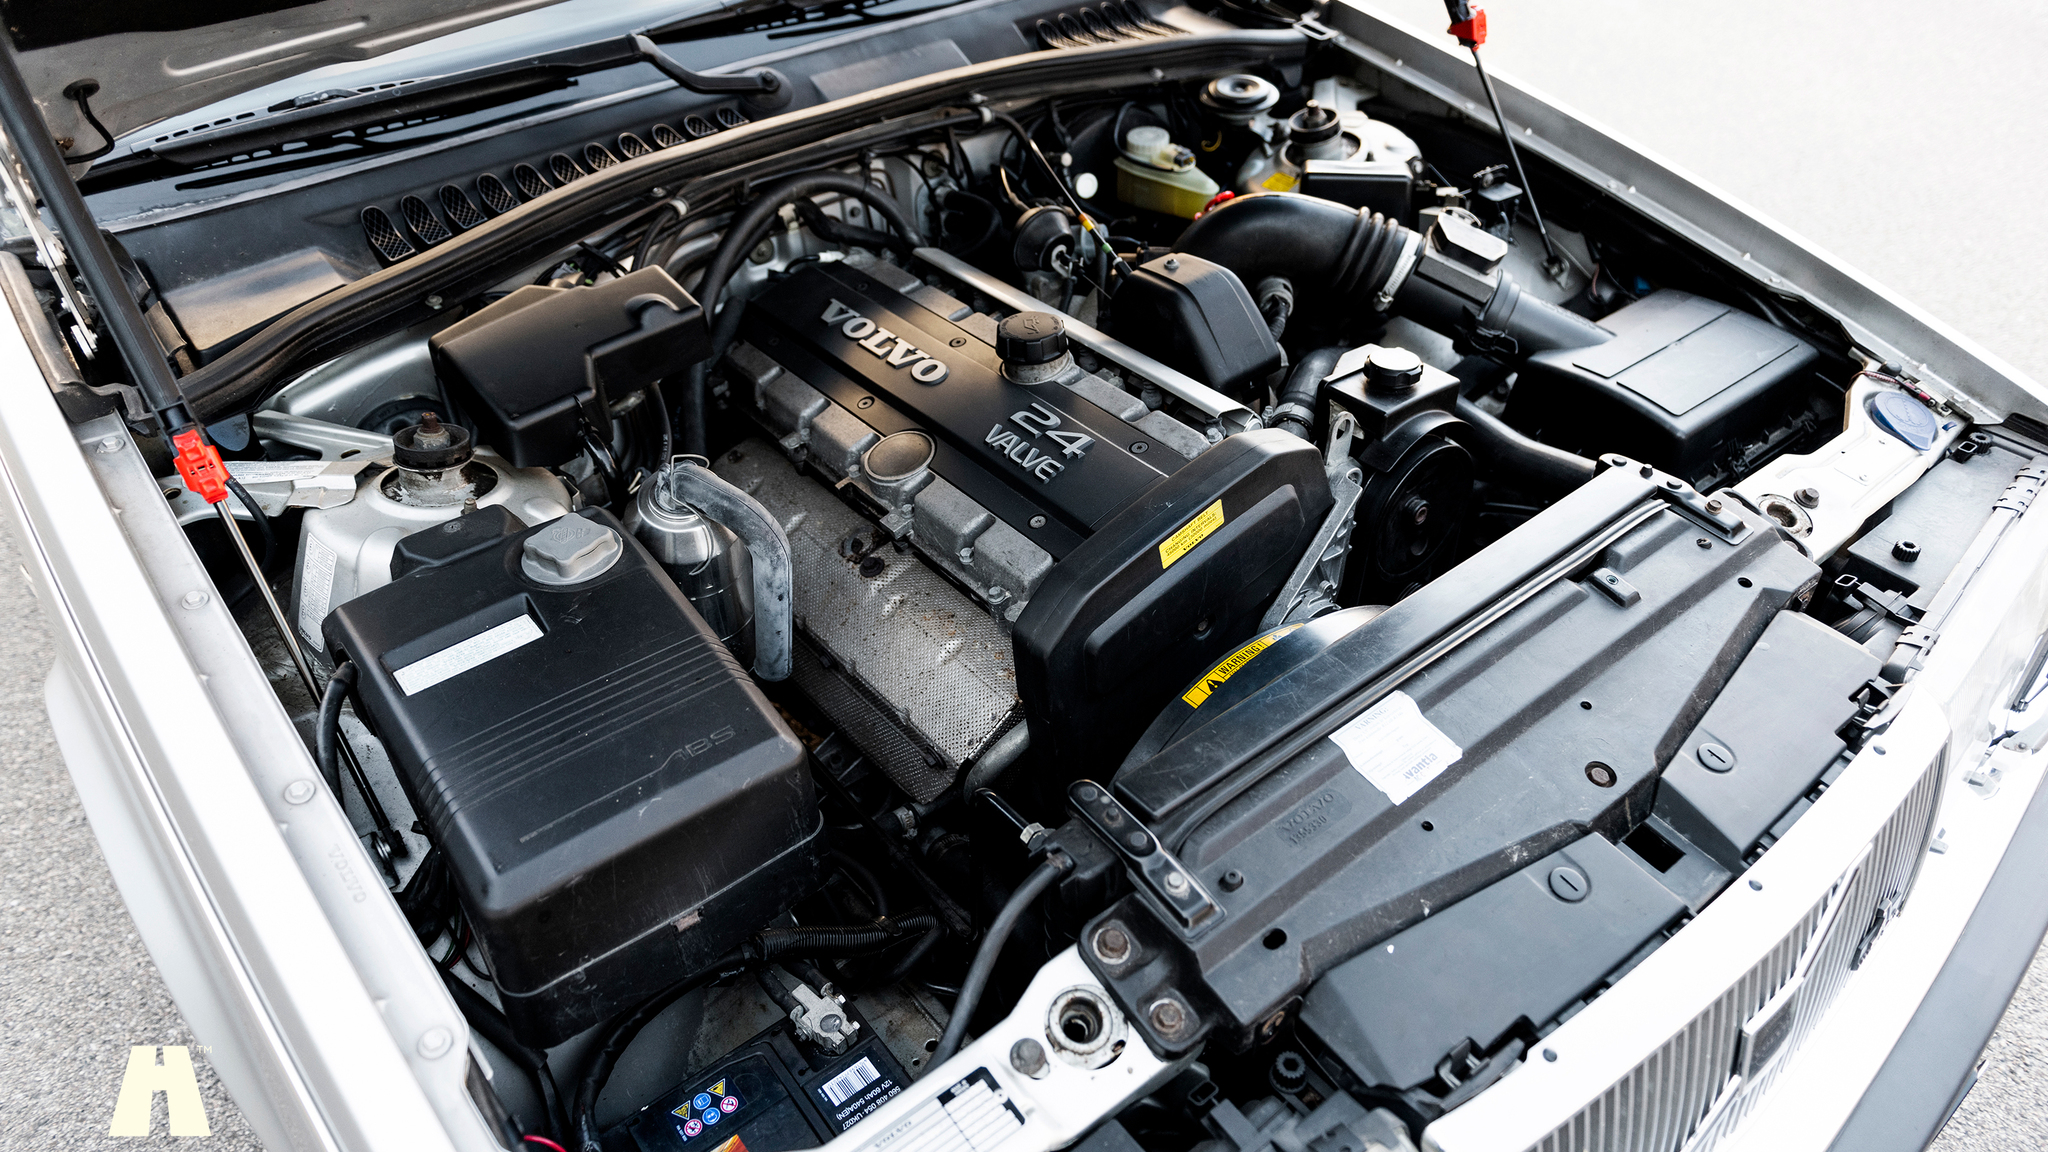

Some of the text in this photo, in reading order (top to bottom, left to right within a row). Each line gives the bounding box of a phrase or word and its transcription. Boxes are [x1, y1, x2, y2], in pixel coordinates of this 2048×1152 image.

[820, 298, 949, 385] VOLVO
[984, 423, 1064, 484] VALVE
[1009, 402, 1095, 460] 24
[672, 725, 736, 761] ABS
[1279, 793, 1334, 832] VOLVO
[328, 843, 367, 903] VOLVO
[864, 1086, 881, 1101] 60Ah
[880, 1078, 893, 1091] 12V
